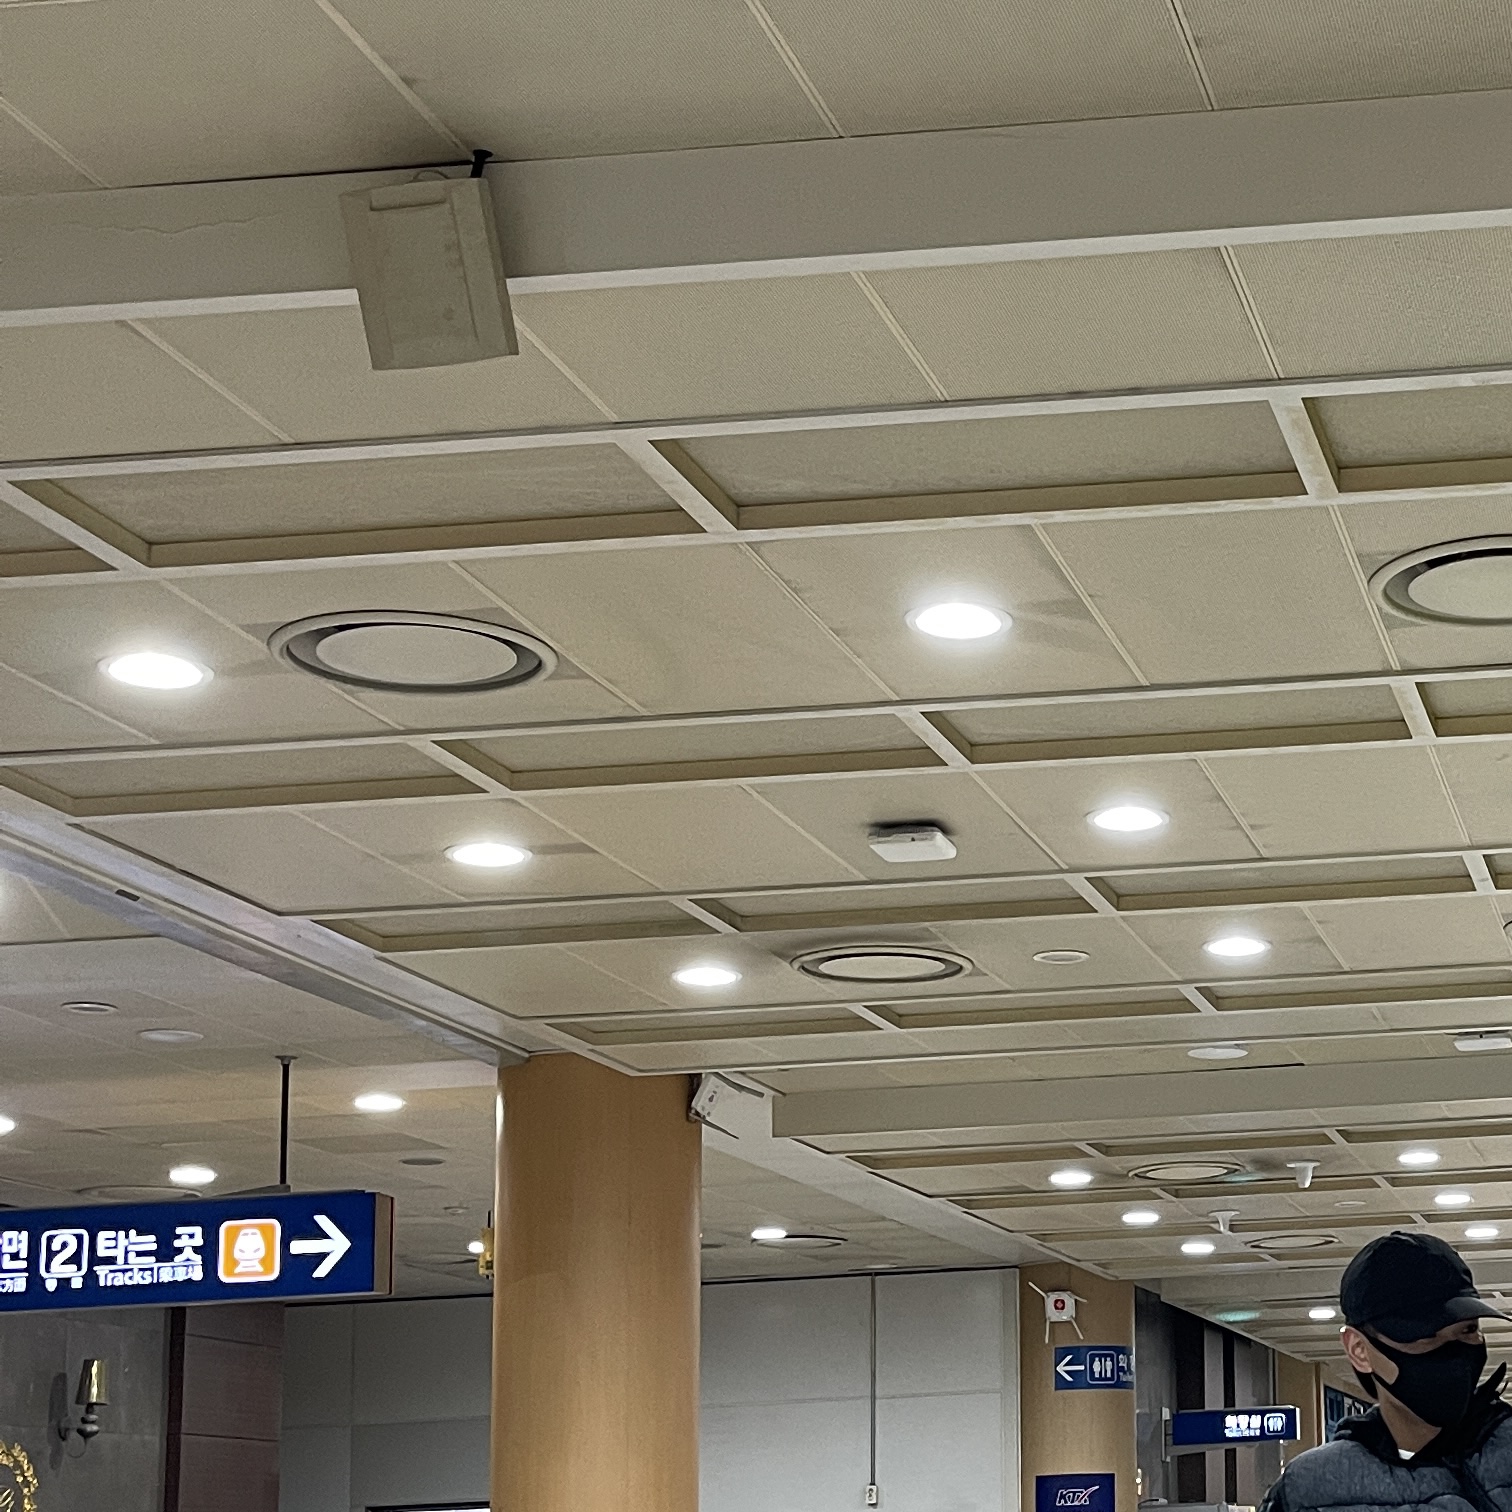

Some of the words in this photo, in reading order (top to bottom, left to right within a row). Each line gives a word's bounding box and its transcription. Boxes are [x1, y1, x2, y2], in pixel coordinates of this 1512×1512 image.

[96, 1229, 158, 1265] 타는
[173, 1226, 204, 1263] 곳
[98, 1267, 153, 1287] Tracks
[1056, 1485, 1099, 1506] KTX
